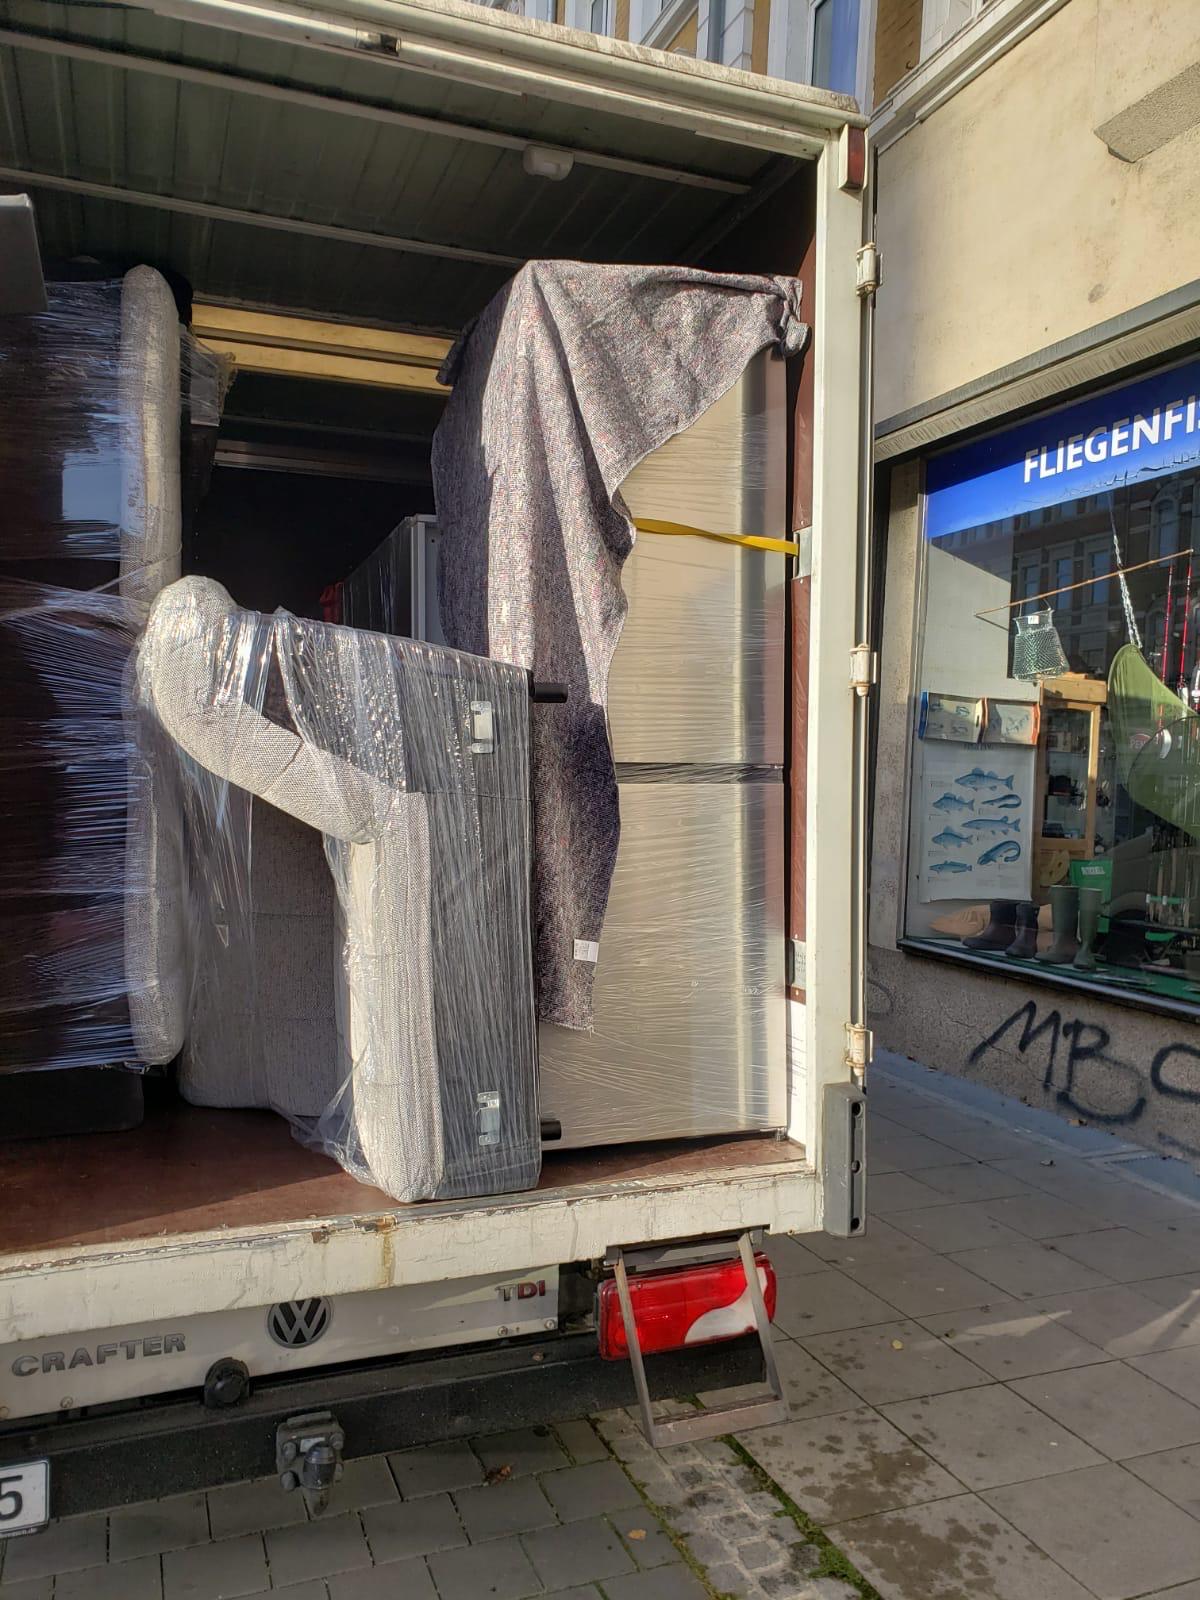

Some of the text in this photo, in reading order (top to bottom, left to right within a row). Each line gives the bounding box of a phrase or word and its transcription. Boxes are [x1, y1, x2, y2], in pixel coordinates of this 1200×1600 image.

[1023, 395, 1200, 484] FLIEGENFI
[494, 1279, 546, 1302] TDI
[11, 1333, 186, 1377] CRAFTER
